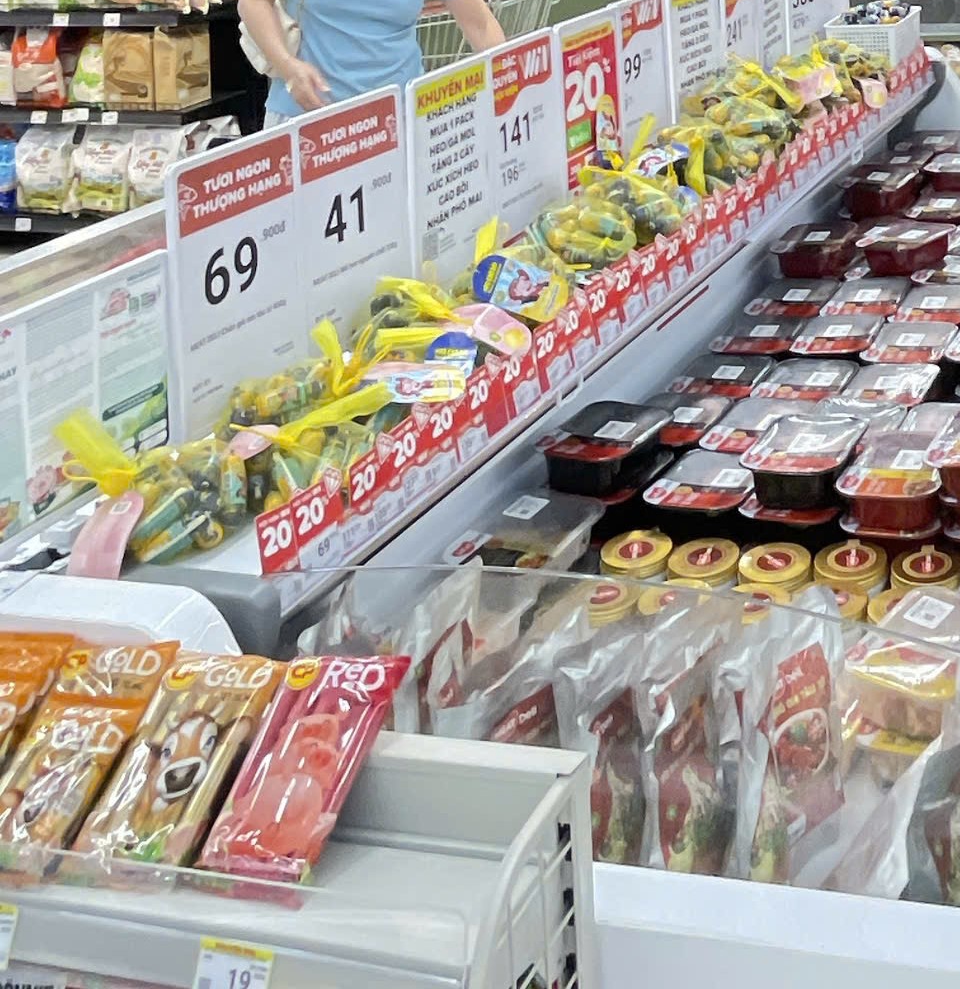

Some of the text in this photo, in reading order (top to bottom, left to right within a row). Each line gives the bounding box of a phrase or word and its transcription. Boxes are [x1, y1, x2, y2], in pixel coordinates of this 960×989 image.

[727, 17, 743, 48] 241
[624, 53, 642, 84] 99
[417, 78, 463, 110] KHUYẾN
[320, 116, 378, 146] TƯƠI NGON
[499, 111, 531, 153] 141
[312, 131, 388, 169] THƯỢNG HẠNG
[203, 158, 271, 195] TƯƠI NGON
[502, 165, 519, 187] 196
[193, 172, 282, 219] THƯỢNG HẠNG
[324, 185, 365, 243] 41
[204, 237, 258, 305] 69
[589, 287, 606, 313] 20
[536, 331, 555, 359] 20
[502, 355, 521, 383] 20
[468, 379, 489, 411] 20
[430, 406, 454, 439] 20
[392, 432, 416, 468] 20
[352, 464, 376, 501] 20
[296, 497, 325, 535] 20
[261, 520, 292, 558] 20
[317, 537, 331, 557] 69
[229, 968, 251, 989] 19
